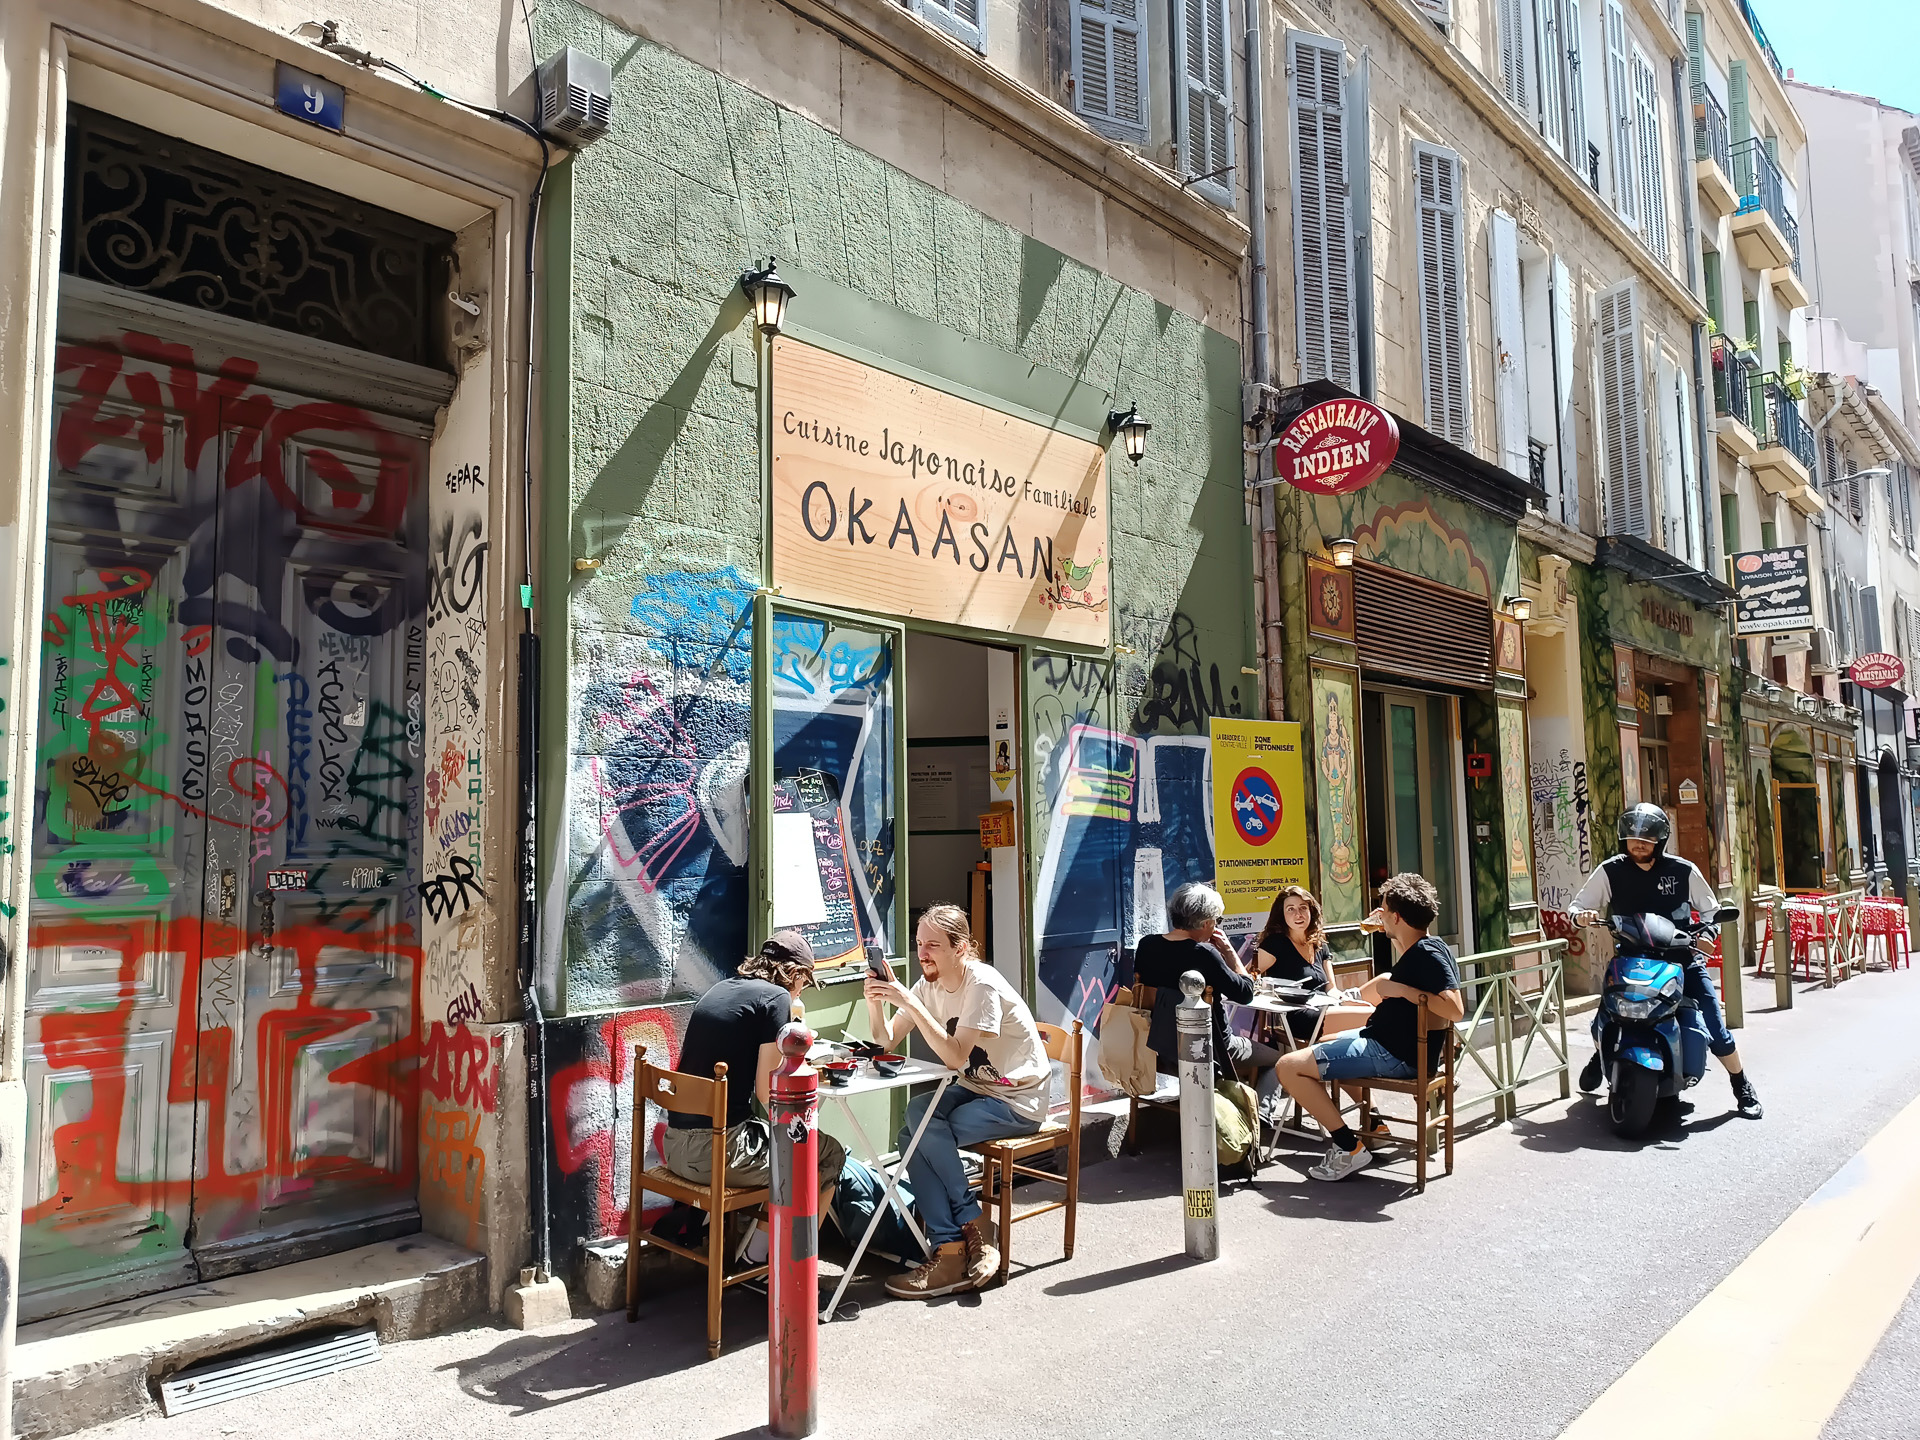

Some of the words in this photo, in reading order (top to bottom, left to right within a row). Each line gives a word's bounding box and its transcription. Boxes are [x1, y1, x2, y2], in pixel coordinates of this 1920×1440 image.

[302, 81, 325, 115] 9
[1282, 403, 1379, 454] RESTAURANT
[783, 411, 869, 456] Cuisine
[879, 428, 1017, 497] Japonaise
[1023, 479, 1098, 519] Familiale
[1293, 440, 1371, 480] INDIEN
[1762, 551, 1790, 563] Midi
[1772, 560, 1798, 571] Soir
[1741, 572, 1773, 581] LIVRAISON
[1774, 568, 1803, 577] GRATUITE
[1852, 653, 1900, 672] RESTAURANT
[1855, 668, 1899, 682] PAKISTANAIS
[1254, 736, 1272, 744] ZONE
[1218, 859, 1270, 868] STATIONNEMENT
[1270, 858, 1304, 866] INTERDIT
[1250, 885, 1277, 893] SEPTEMBRE
[1222, 921, 1253, 931] marseille.fr
[1187, 1189, 1213, 1208] NIFER
[1188, 1207, 1213, 1218] UDM
